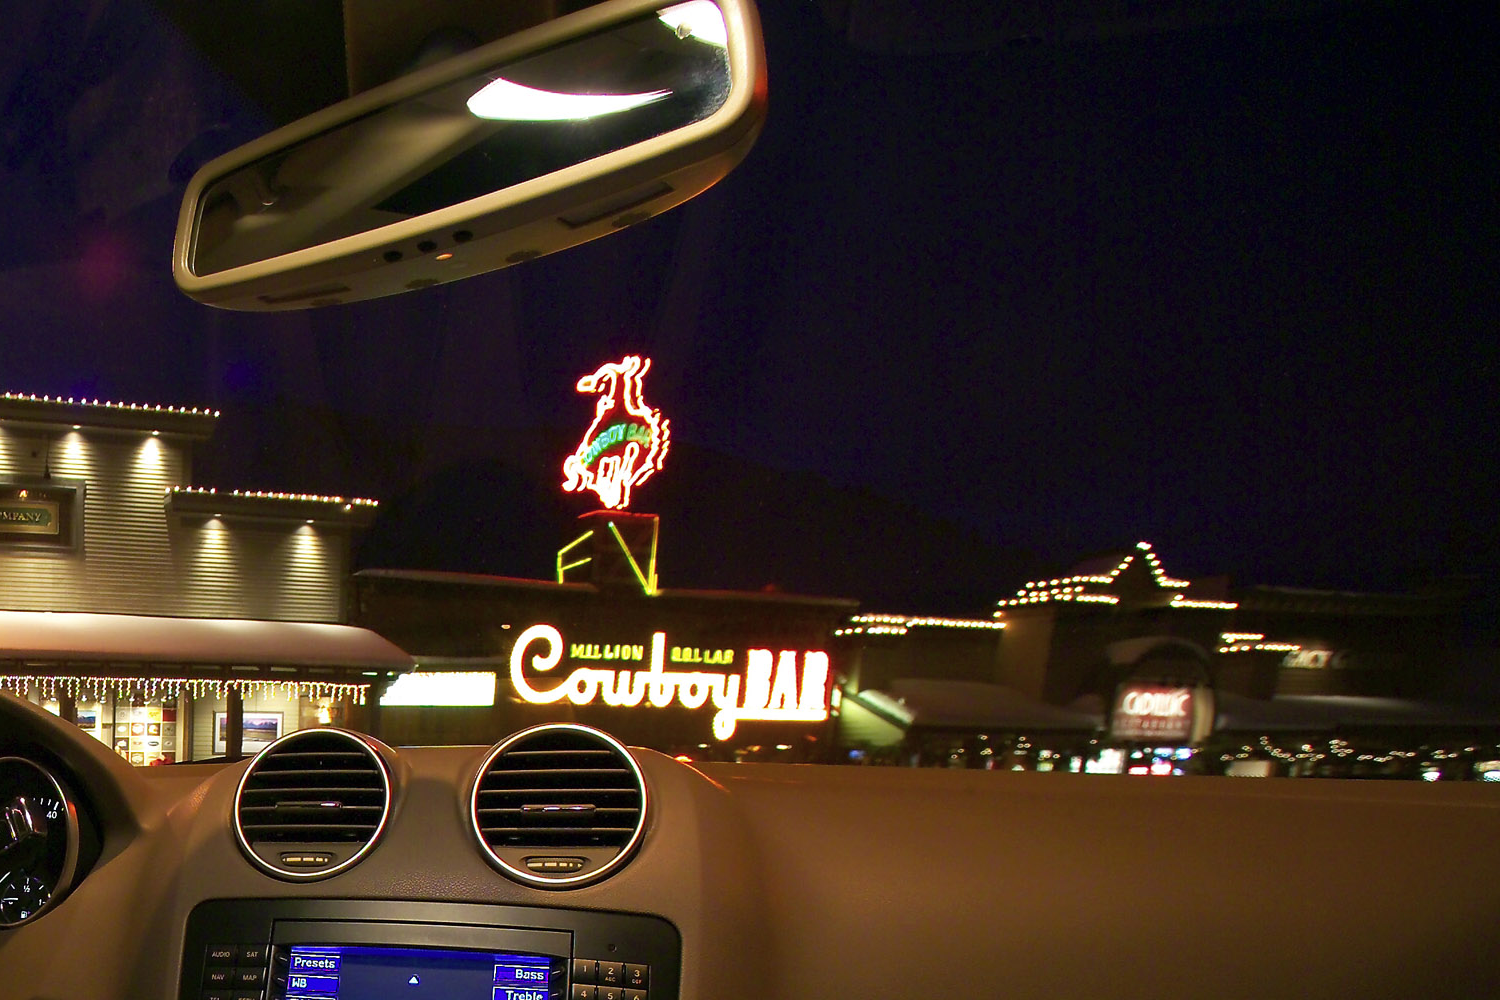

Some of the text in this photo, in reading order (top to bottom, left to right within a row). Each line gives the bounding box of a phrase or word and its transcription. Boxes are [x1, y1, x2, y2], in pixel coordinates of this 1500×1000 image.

[570, 643, 734, 665] MILLION DOLLAR
[510, 624, 830, 741] Cowboy BAR
[46, 811, 58, 819] 40
[294, 956, 336, 970] Presets
[514, 968, 545, 982] Bass
[607, 967, 614, 975] 2
[634, 969, 641, 978] 3
[291, 977, 307, 989] WB
[580, 990, 587, 998] 4
[607, 992, 614, 1000] 5
